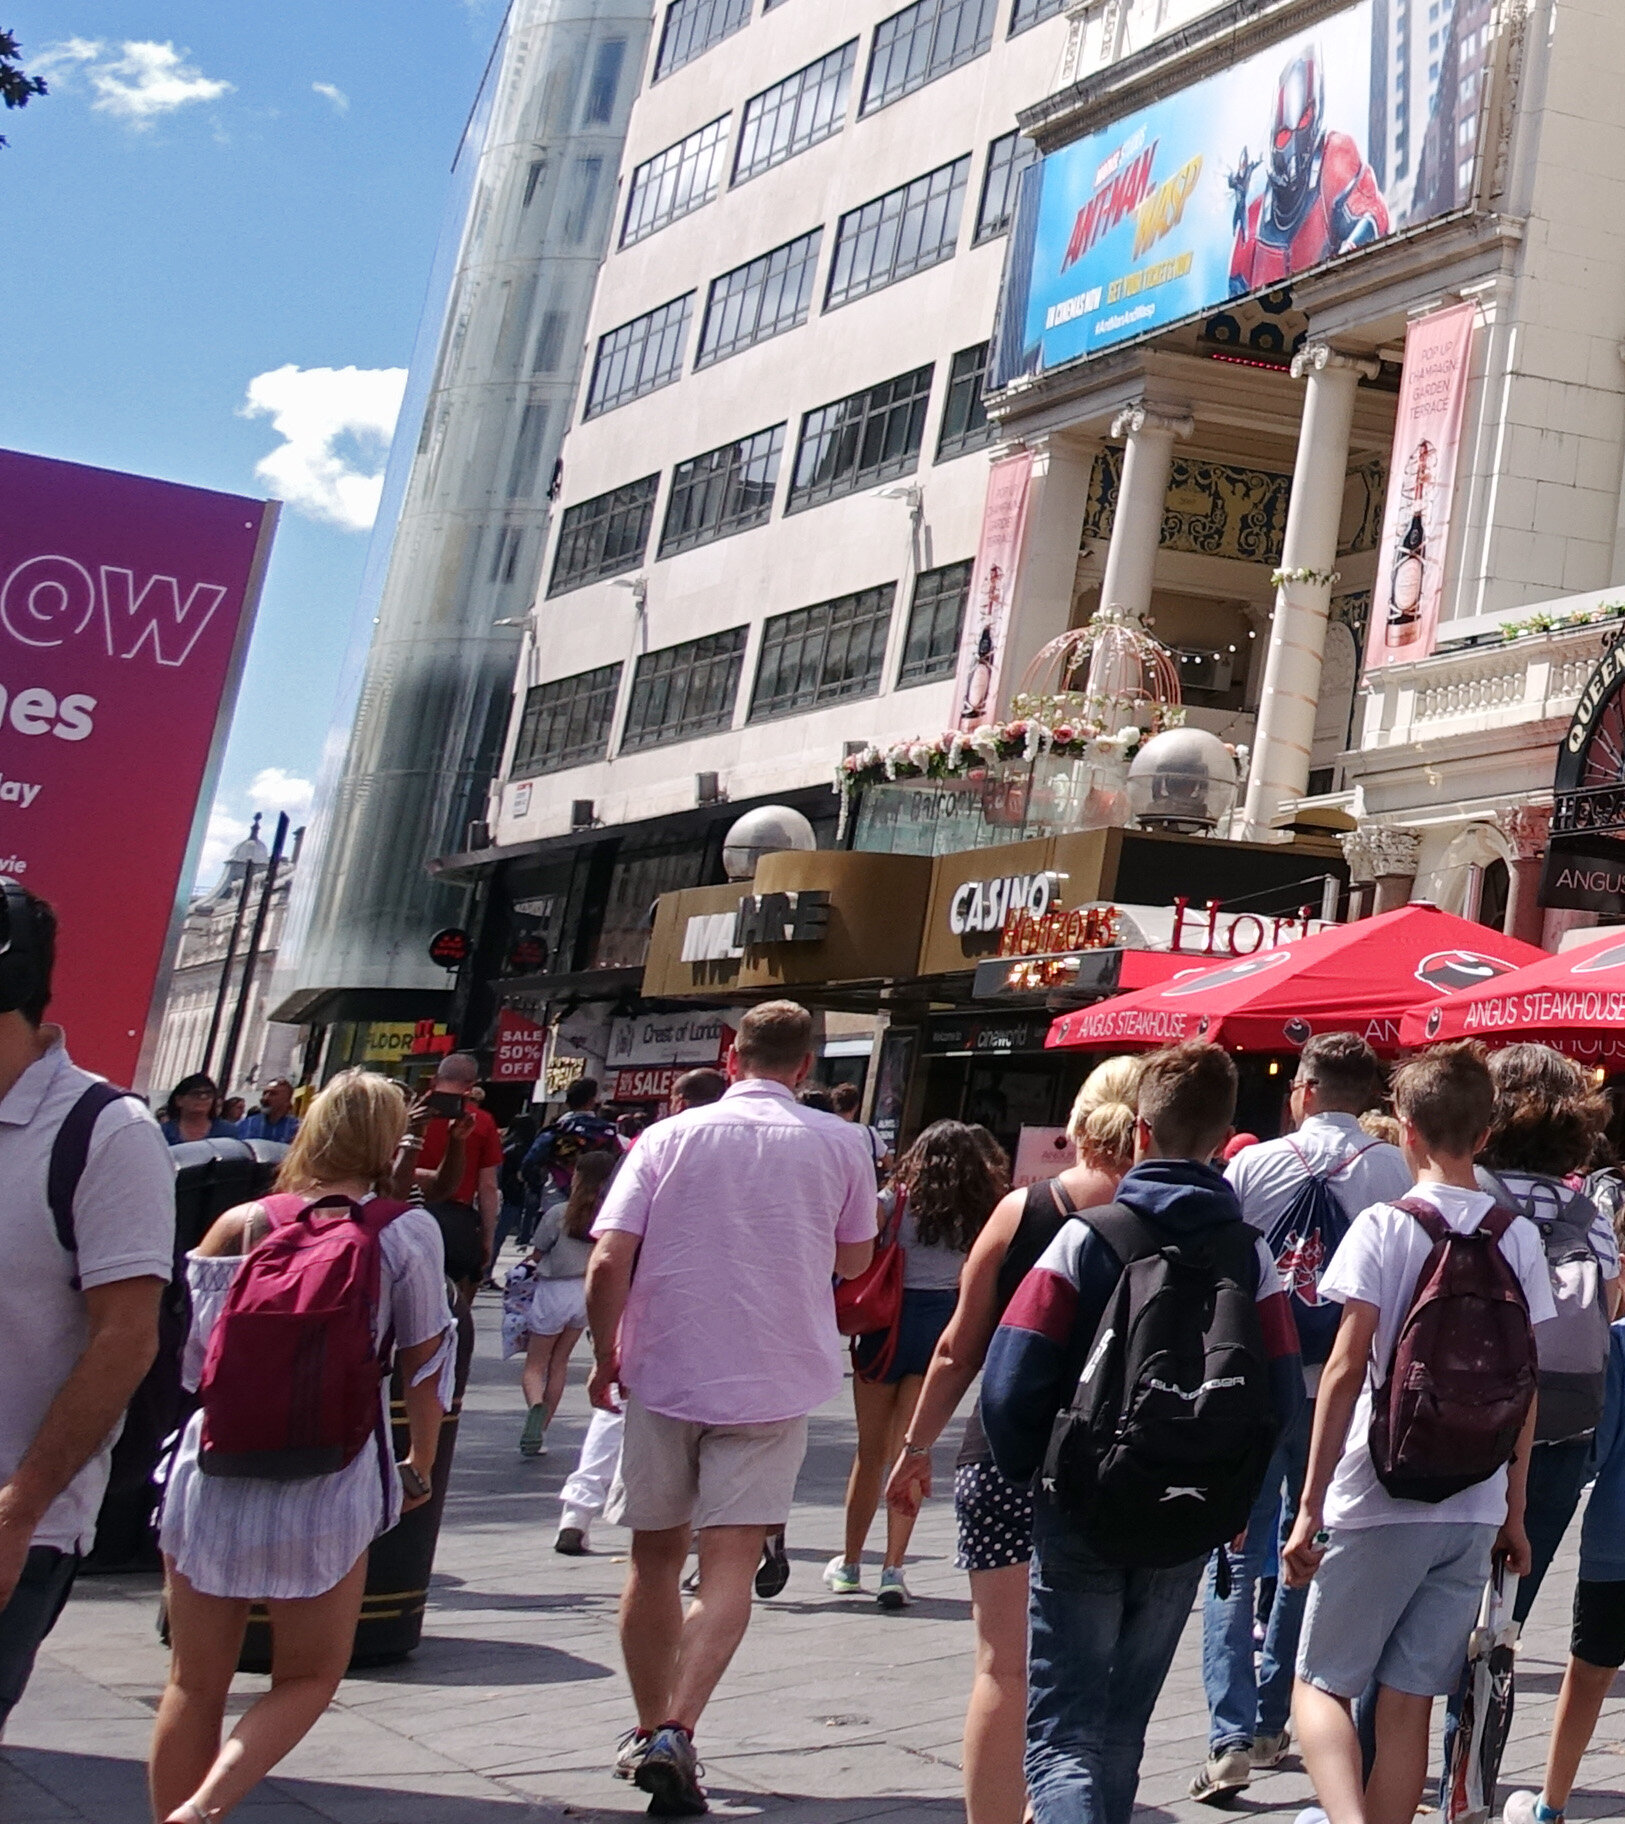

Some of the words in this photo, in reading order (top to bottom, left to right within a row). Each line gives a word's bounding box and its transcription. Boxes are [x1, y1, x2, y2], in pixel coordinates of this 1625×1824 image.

[1413, 379, 1451, 402] GARDEN
[1410, 397, 1449, 420] TERRACE
[0, 773, 42, 808] ay
[951, 872, 1049, 935] CASINO
[1464, 996, 1519, 1029] ANGUS
[502, 1030, 543, 1042] SALE
[643, 1023, 674, 1044] Crest
[675, 1021, 687, 1041] of
[1078, 1015, 1115, 1037] ANGUS
[1117, 1012, 1188, 1037] STEAKHOUSE
[499, 1045, 542, 1060] 50%
[501, 1062, 534, 1075] OFF
[632, 1071, 672, 1096] SALE
